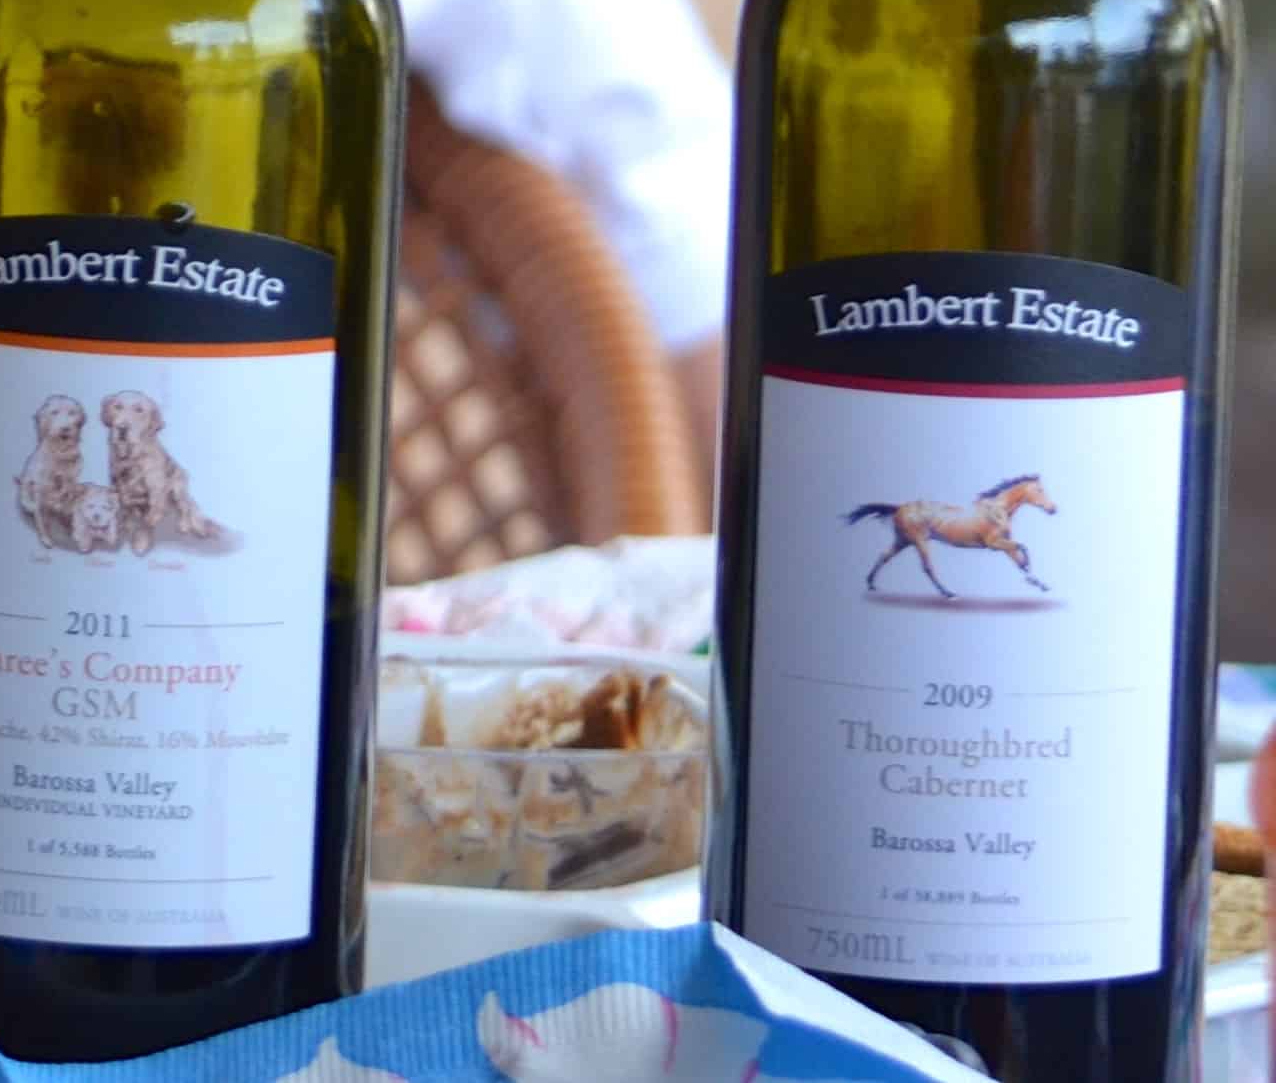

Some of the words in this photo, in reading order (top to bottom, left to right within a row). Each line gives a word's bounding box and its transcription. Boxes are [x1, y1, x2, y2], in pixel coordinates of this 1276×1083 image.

[148, 245, 285, 307] Estate
[808, 284, 1001, 337] Lambert
[1006, 286, 1140, 348] Estate
[64, 610, 132, 638] 2011
[84, 652, 243, 694] Company
[52, 686, 139, 720] GSM
[923, 683, 993, 708] 2009
[839, 718, 1073, 767] Thoroughbred
[12, 764, 96, 794] Barossa
[105, 772, 178, 802] Valley
[879, 763, 1028, 798] Cabernet
[101, 803, 195, 820] VINEYARD
[870, 826, 956, 854] Barossa
[964, 831, 1037, 861] Valley
